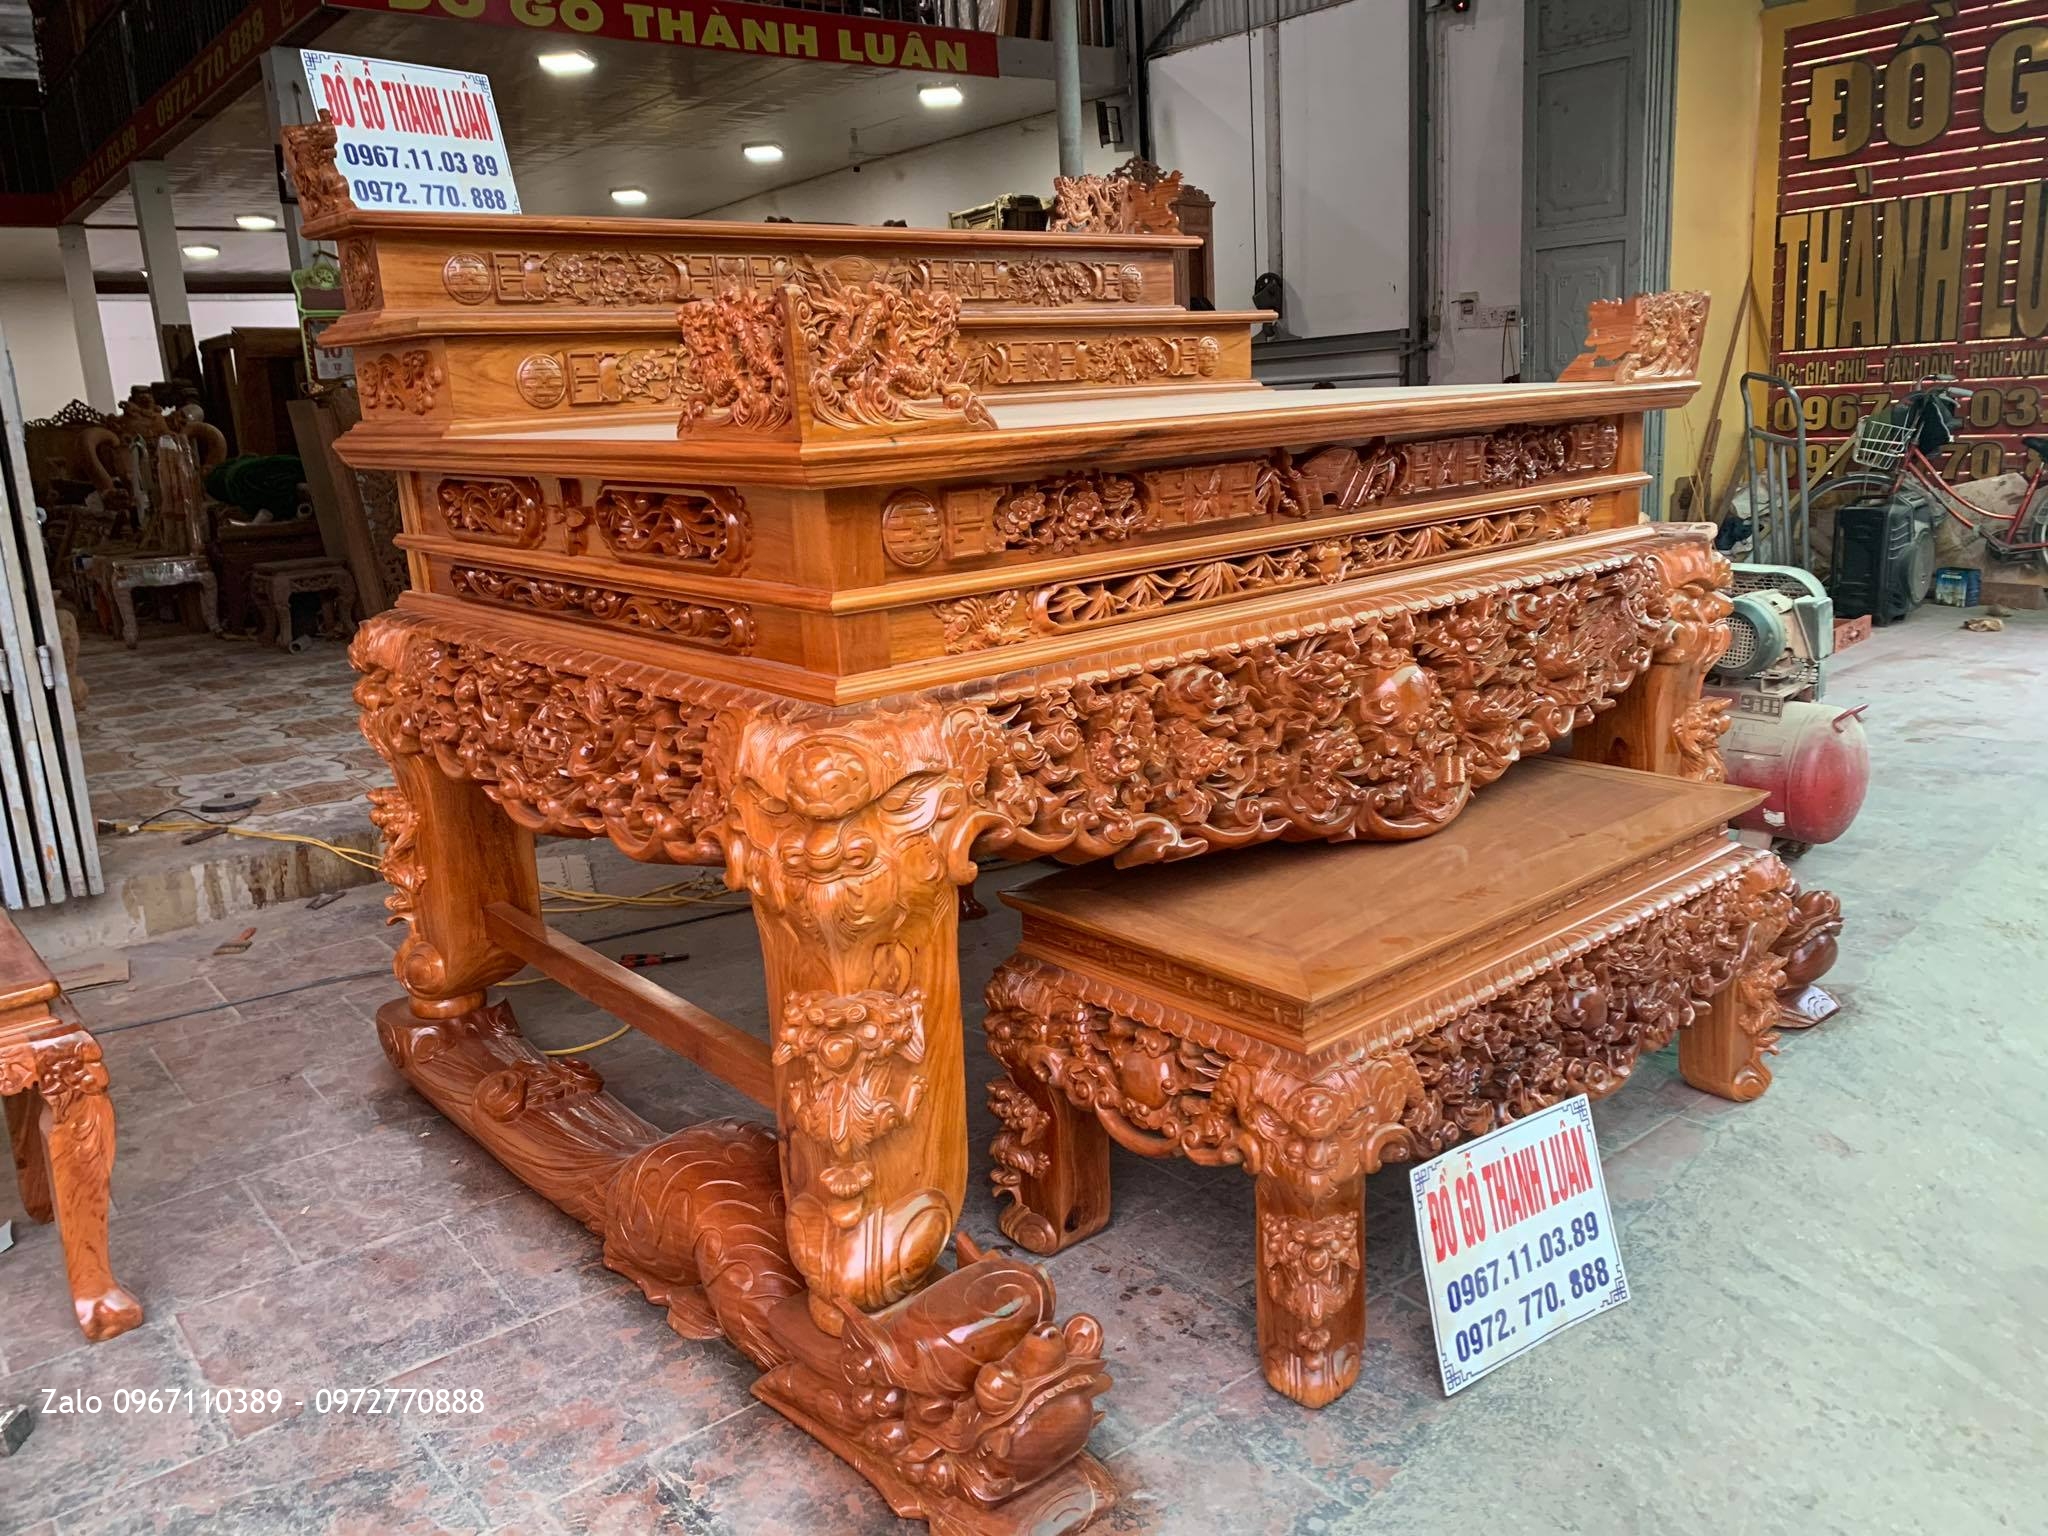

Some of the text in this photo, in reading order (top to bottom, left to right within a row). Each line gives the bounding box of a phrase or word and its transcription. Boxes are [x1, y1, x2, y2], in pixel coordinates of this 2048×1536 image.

[624, 3, 818, 57] THÀNH
[838, 30, 968, 71] LUÂN
[1806, 2, 1957, 161] ĐỒ
[321, 60, 494, 141] ĐỒ GỖ THÀNH LUÂN
[1778, 167, 1968, 351] THÀNH
[1805, 361, 1829, 385] GIA
[1834, 353, 1866, 383] PHÚ
[1969, 346, 2004, 377] PHÚ
[1427, 1120, 1593, 1264] ĐỒ GỖ THÀNH LUÂN
[1446, 1211, 1599, 1313] 0967.11.03.89
